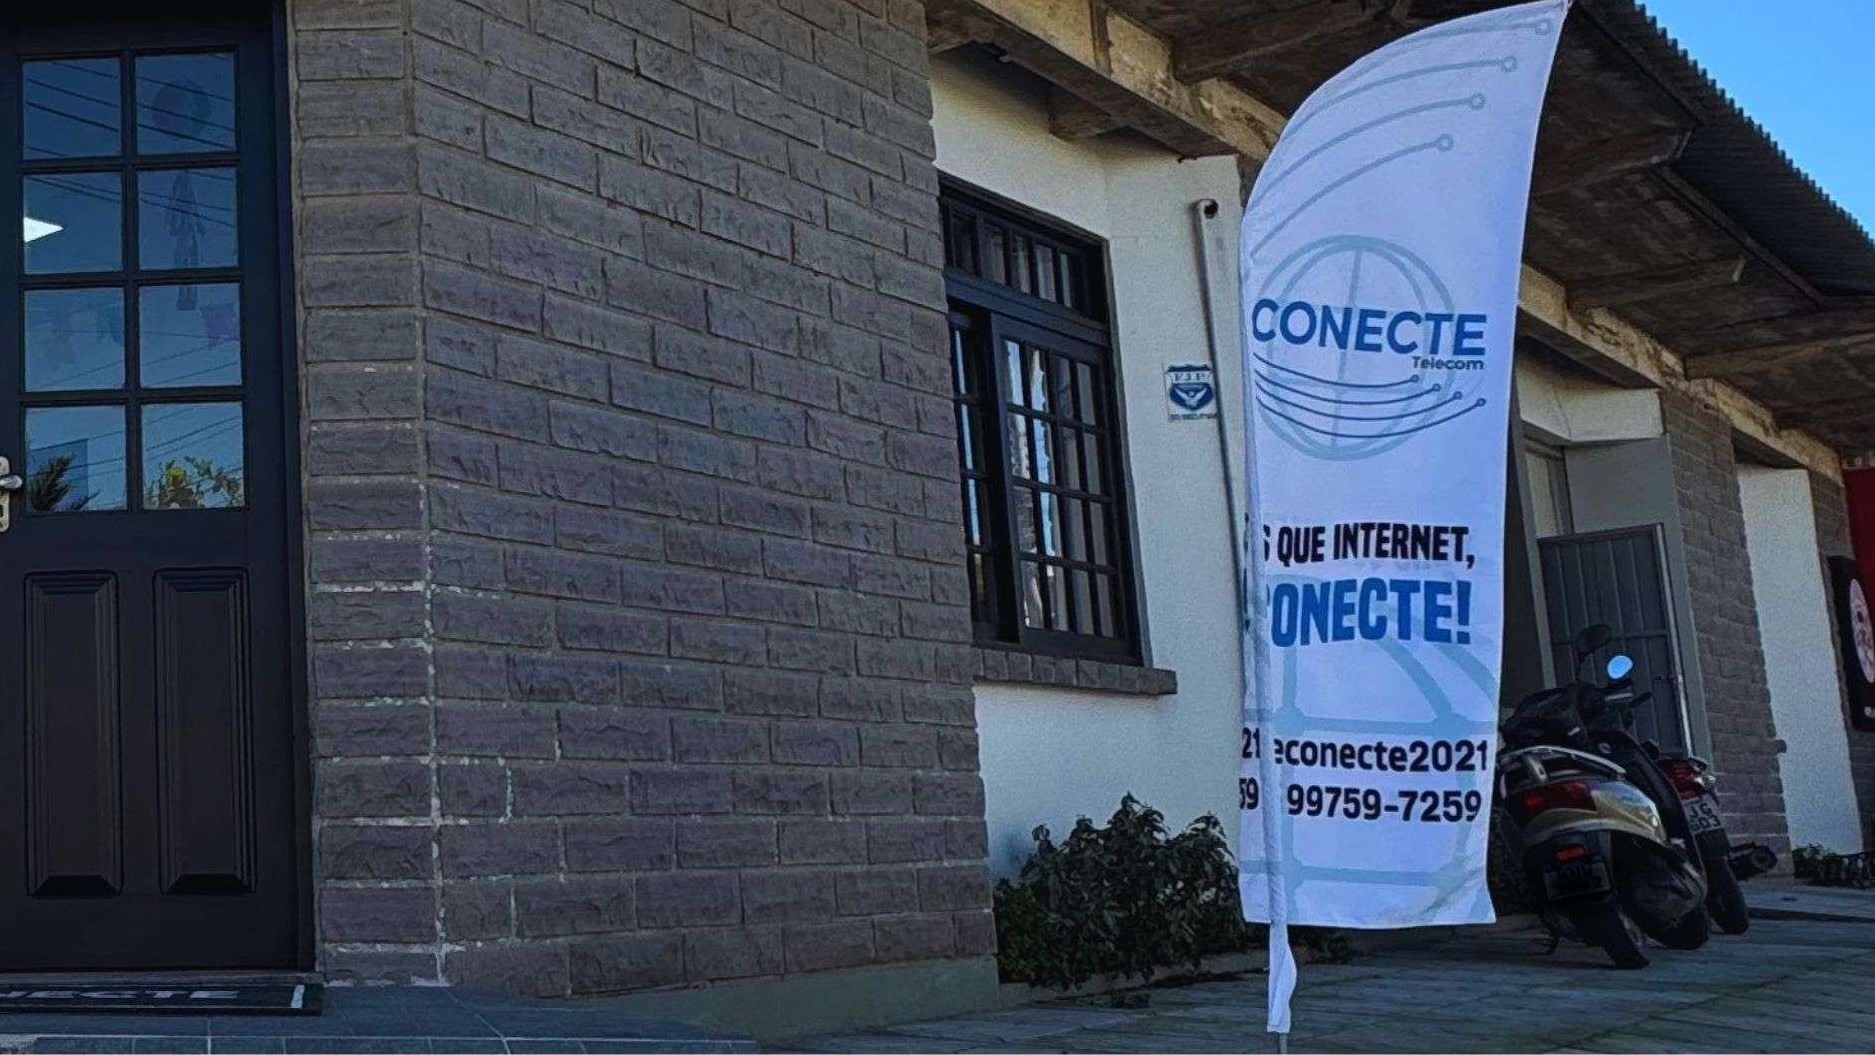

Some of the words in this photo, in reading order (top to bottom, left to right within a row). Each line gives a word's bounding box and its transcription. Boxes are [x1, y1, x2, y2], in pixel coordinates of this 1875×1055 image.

[1252, 299, 1486, 355] CONECTE
[1412, 355, 1484, 370] Telecom
[1277, 525, 1326, 567] QUE
[1333, 522, 1475, 569] INTERNET,
[1266, 578, 1472, 647] ONECTE!
[1287, 783, 1482, 822] 99759-7259
